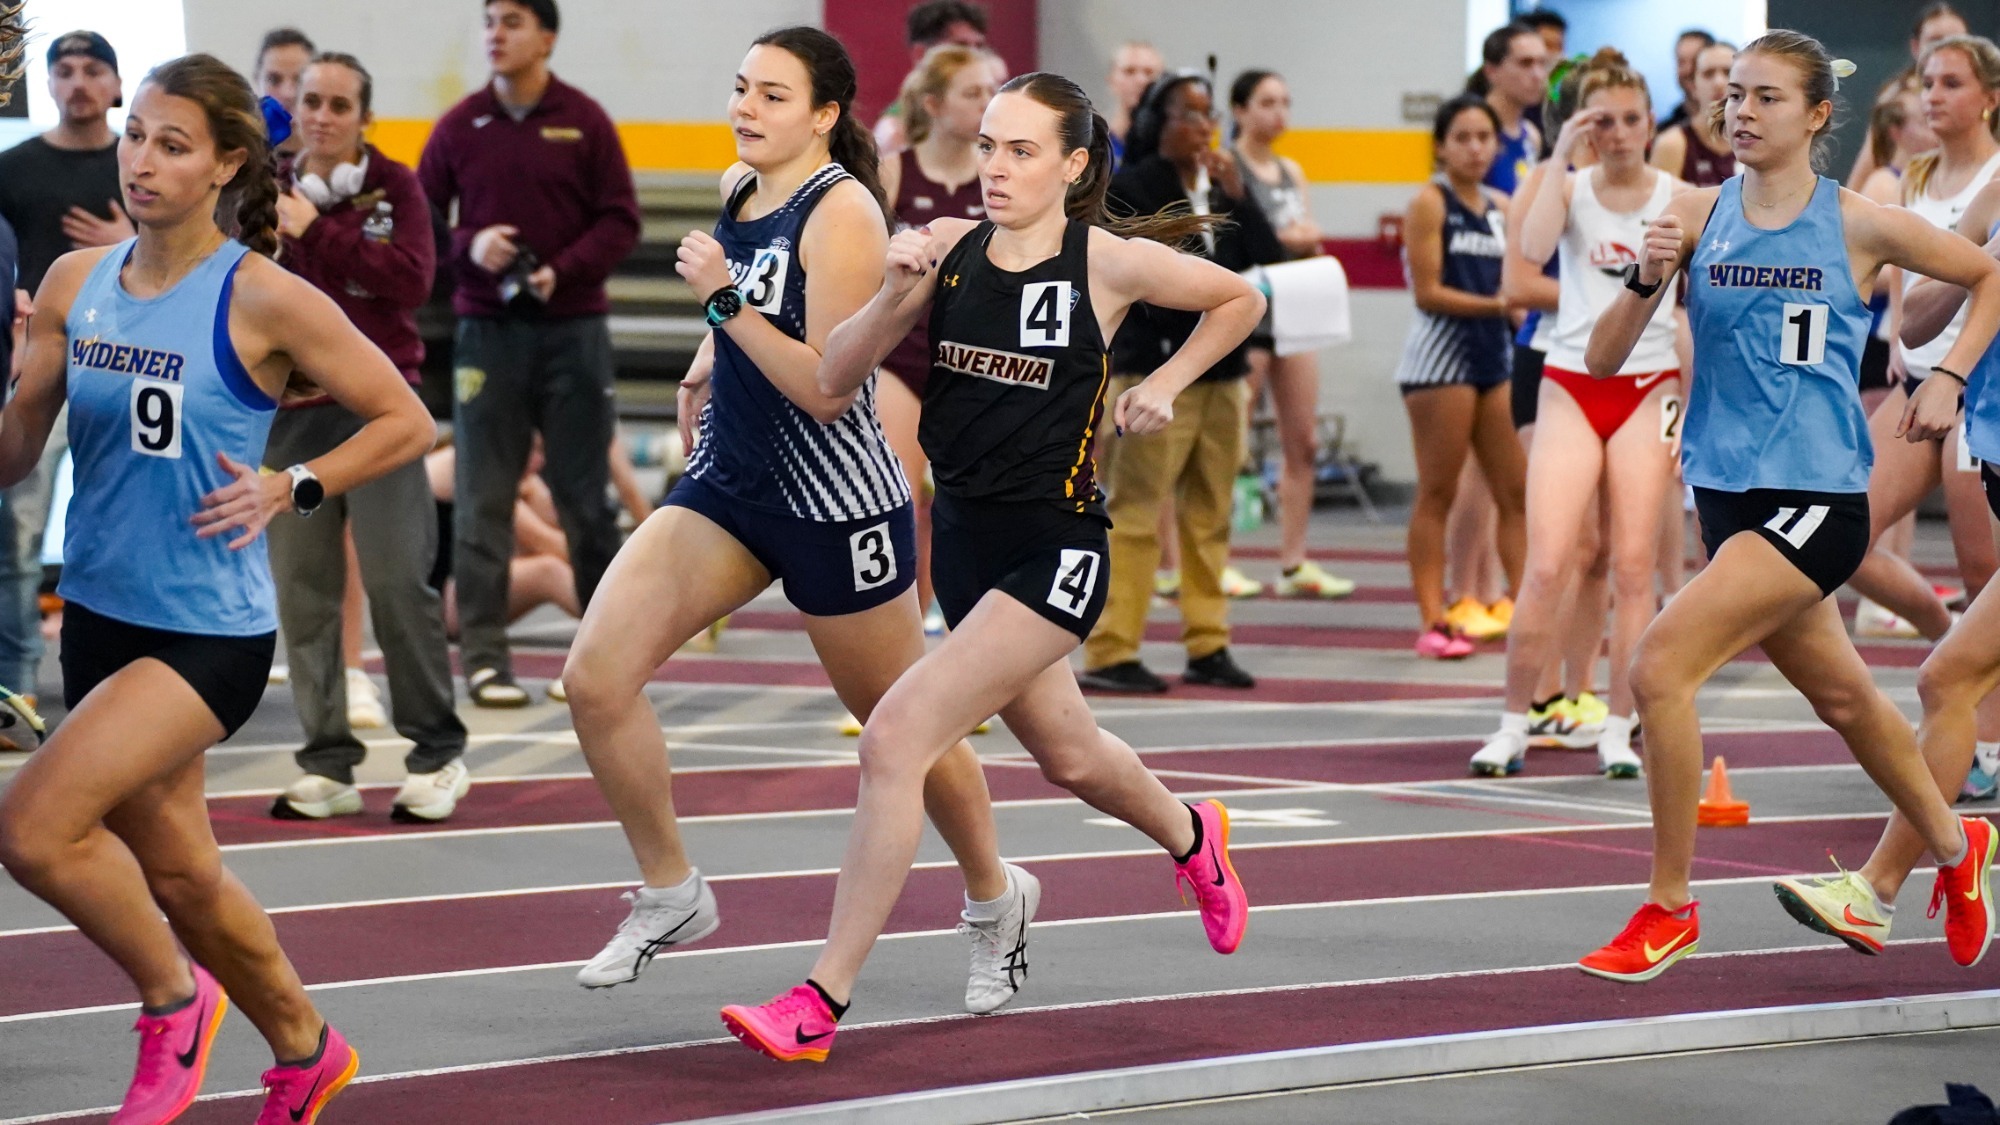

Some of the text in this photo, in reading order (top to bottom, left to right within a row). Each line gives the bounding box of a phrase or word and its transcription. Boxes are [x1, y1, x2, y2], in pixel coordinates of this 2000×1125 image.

[746, 252, 779, 307] 3
[1709, 264, 1823, 291] WIDENER
[1026, 285, 1062, 341] 4
[1789, 309, 1812, 362] 1
[72, 339, 185, 382] WIDENER
[136, 387, 174, 452] 9
[1665, 400, 1680, 438] 2
[857, 530, 890, 584] 3
[1058, 553, 1095, 611] 4
